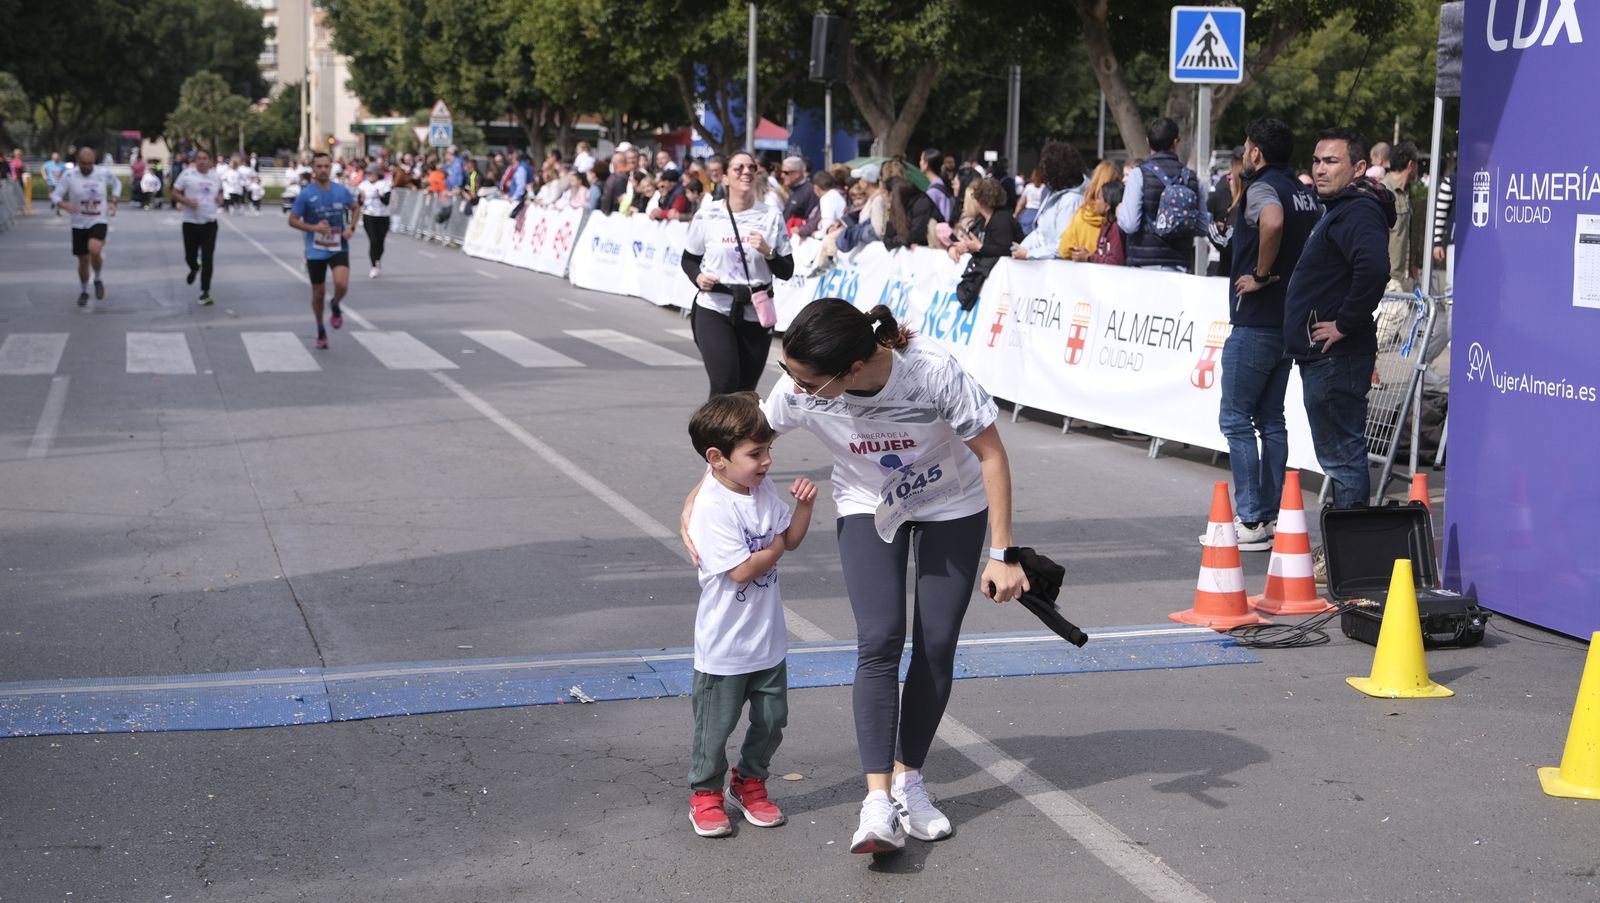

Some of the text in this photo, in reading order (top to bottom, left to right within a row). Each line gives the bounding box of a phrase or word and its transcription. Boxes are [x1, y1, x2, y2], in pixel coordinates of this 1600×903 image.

[1505, 165, 1600, 201] ALMERÍA
[1292, 193, 1319, 211] NEX
[1504, 205, 1552, 224] CIUDAD
[1104, 310, 1195, 353] ALMERÍA
[1098, 346, 1144, 372] CIUDAD
[850, 432, 885, 440] CARRERA
[887, 431, 897, 439] DE
[849, 439, 917, 455] MUJER
[883, 463, 943, 507] 1045
